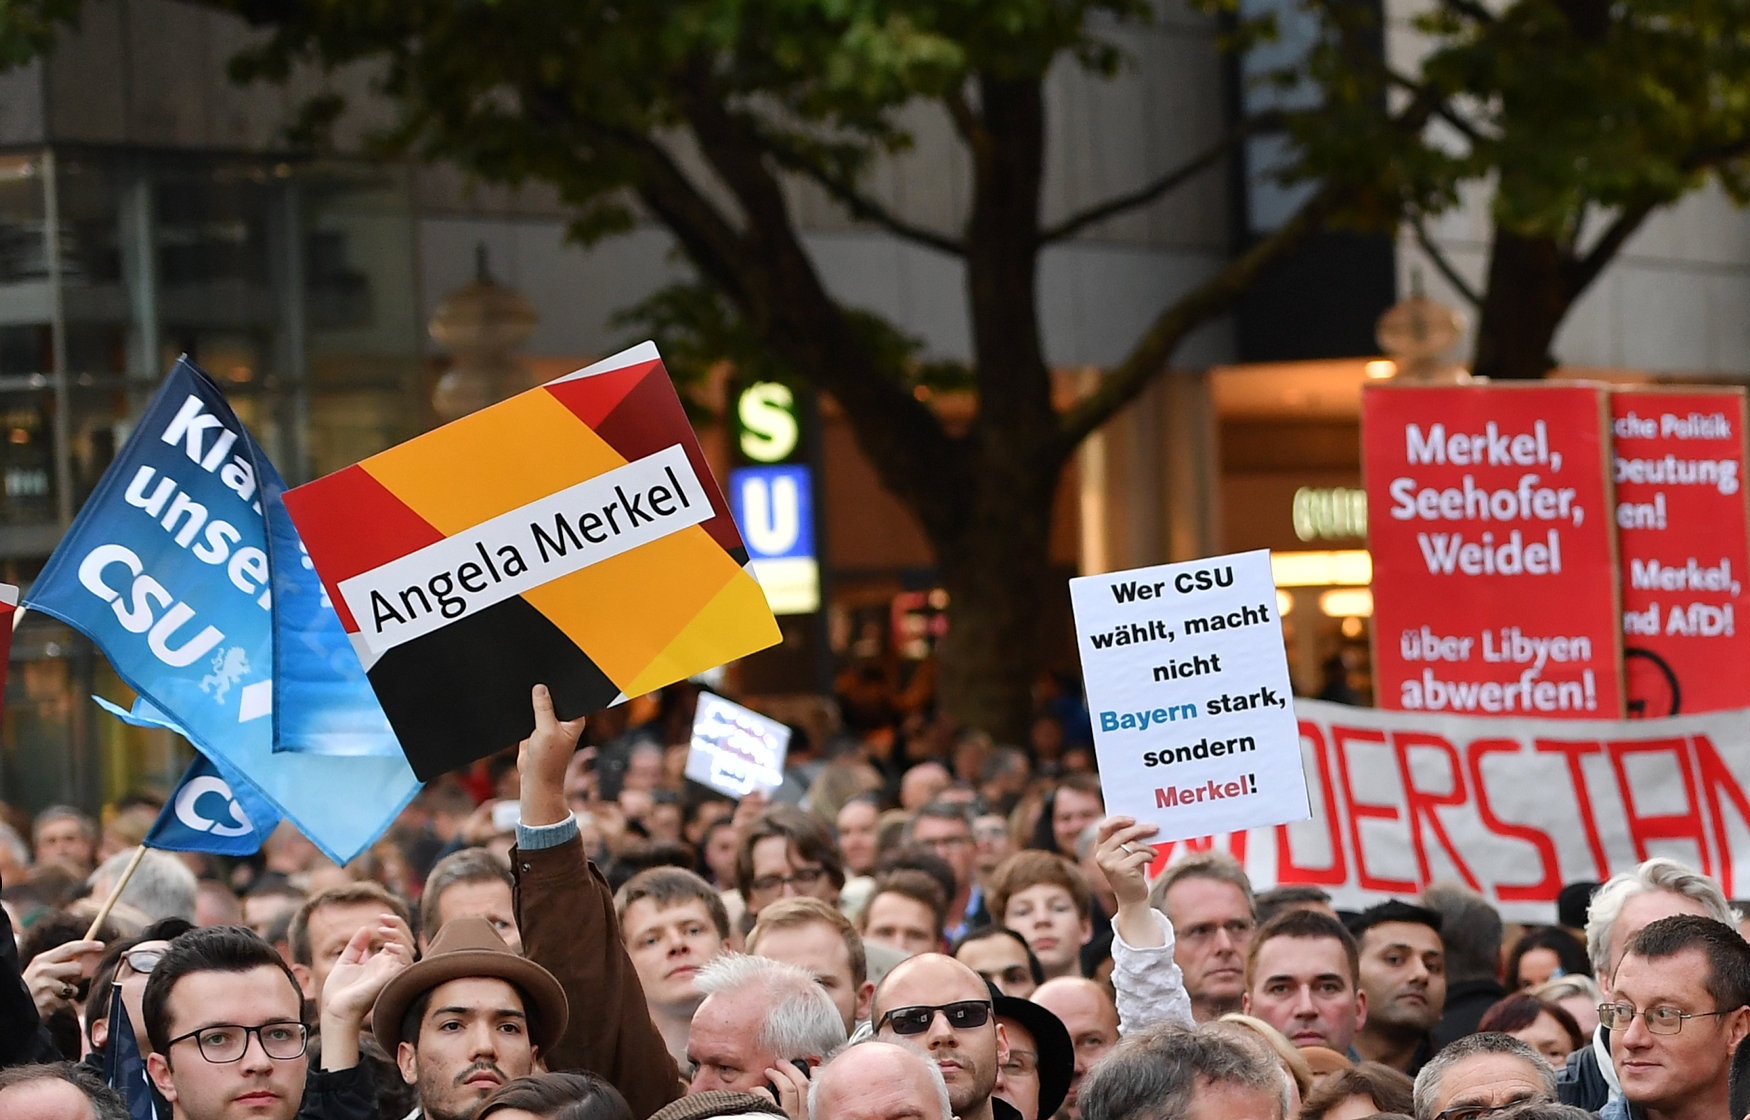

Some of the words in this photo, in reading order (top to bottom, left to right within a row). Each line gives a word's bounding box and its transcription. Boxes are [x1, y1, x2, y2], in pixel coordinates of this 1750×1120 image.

[738, 380, 799, 463] S
[1660, 412, 1732, 440] Politik
[161, 393, 262, 516] Kla
[1405, 419, 1562, 473] Merkel,
[742, 473, 802, 558] U
[1389, 473, 1585, 528] Seehofer,
[368, 545, 528, 635] Angela
[531, 465, 692, 566] Merkel
[1417, 528, 1562, 576] Weidel
[1111, 581, 1165, 604] Wer
[1174, 566, 1234, 594] CSU
[1630, 556, 1741, 598] Merkel,
[78, 543, 225, 668] CSU
[1090, 620, 1175, 650] wählt,
[1184, 604, 1270, 635] macht
[1666, 601, 1735, 637] AfD!
[1153, 653, 1222, 682] nicht
[1400, 624, 1474, 661] über
[1481, 625, 1592, 672] Libyen
[1100, 702, 1198, 732] Bayern
[1206, 686, 1286, 716] stark,
[1400, 667, 1597, 713] abwerfen!
[1143, 735, 1256, 767] sondern
[1155, 773, 1257, 809] Merkel!
